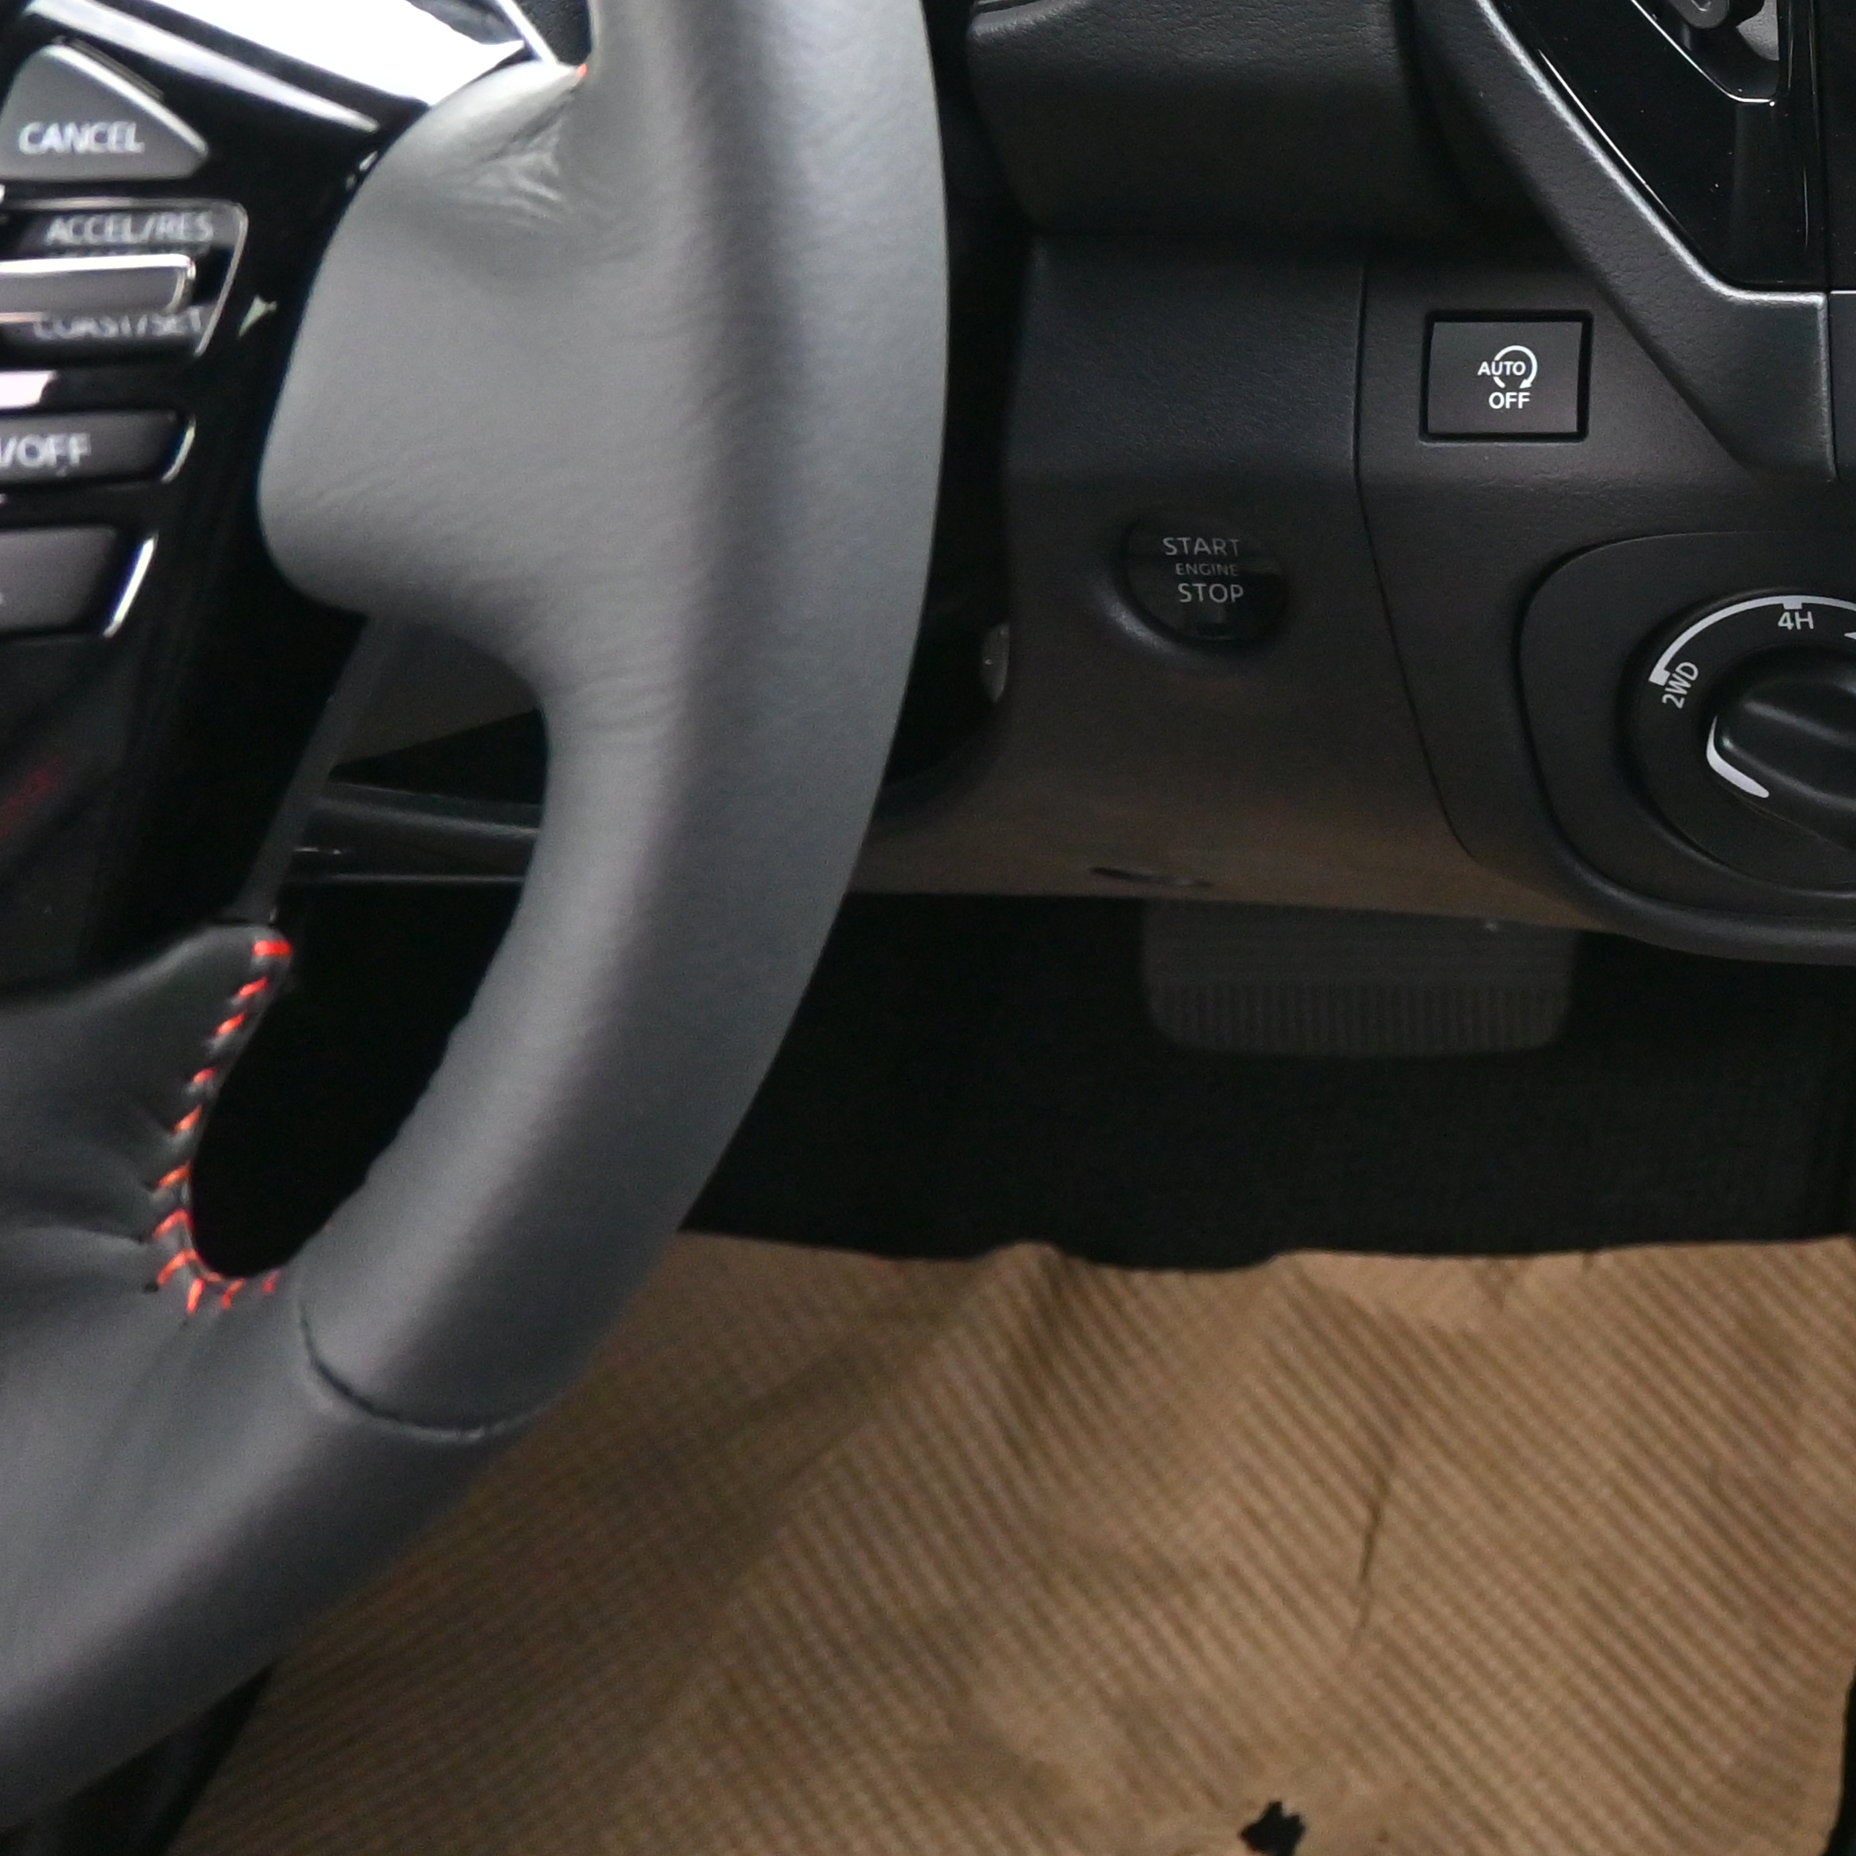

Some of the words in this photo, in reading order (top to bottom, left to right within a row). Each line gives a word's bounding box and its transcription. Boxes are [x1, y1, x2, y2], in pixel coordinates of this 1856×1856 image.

[18, 120, 146, 154] CANCEL
[46, 211, 215, 245] ACCEL/RES
[1477, 360, 1527, 377] AUTO
[1488, 391, 1531, 411] OFF
[1162, 535, 1241, 558] START
[1175, 561, 1239, 576] ENGINE
[1177, 581, 1245, 604] STOP
[1776, 610, 1815, 632] 4H
[1661, 661, 1700, 710] 2WD
